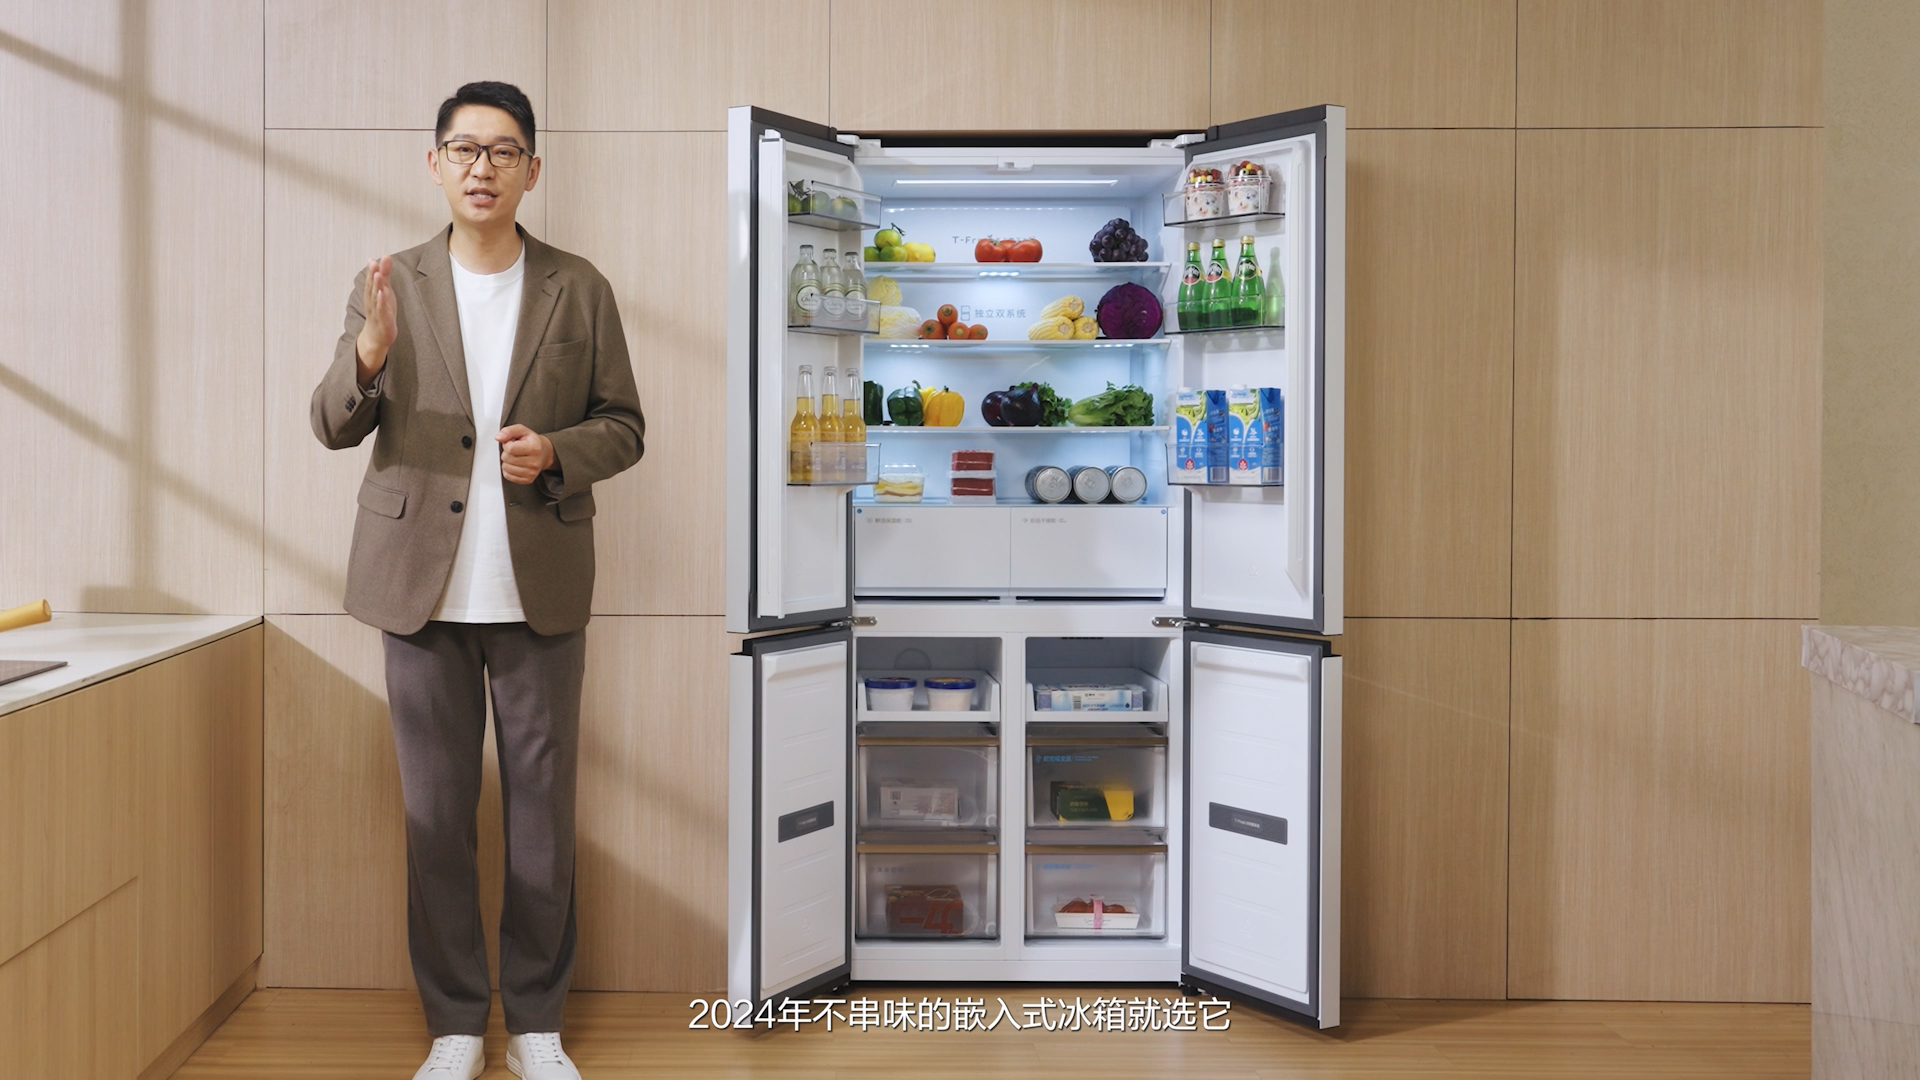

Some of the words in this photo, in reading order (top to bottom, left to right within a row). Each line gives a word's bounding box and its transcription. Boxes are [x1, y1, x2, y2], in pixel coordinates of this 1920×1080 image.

[974, 308, 1027, 319] 独立双系统
